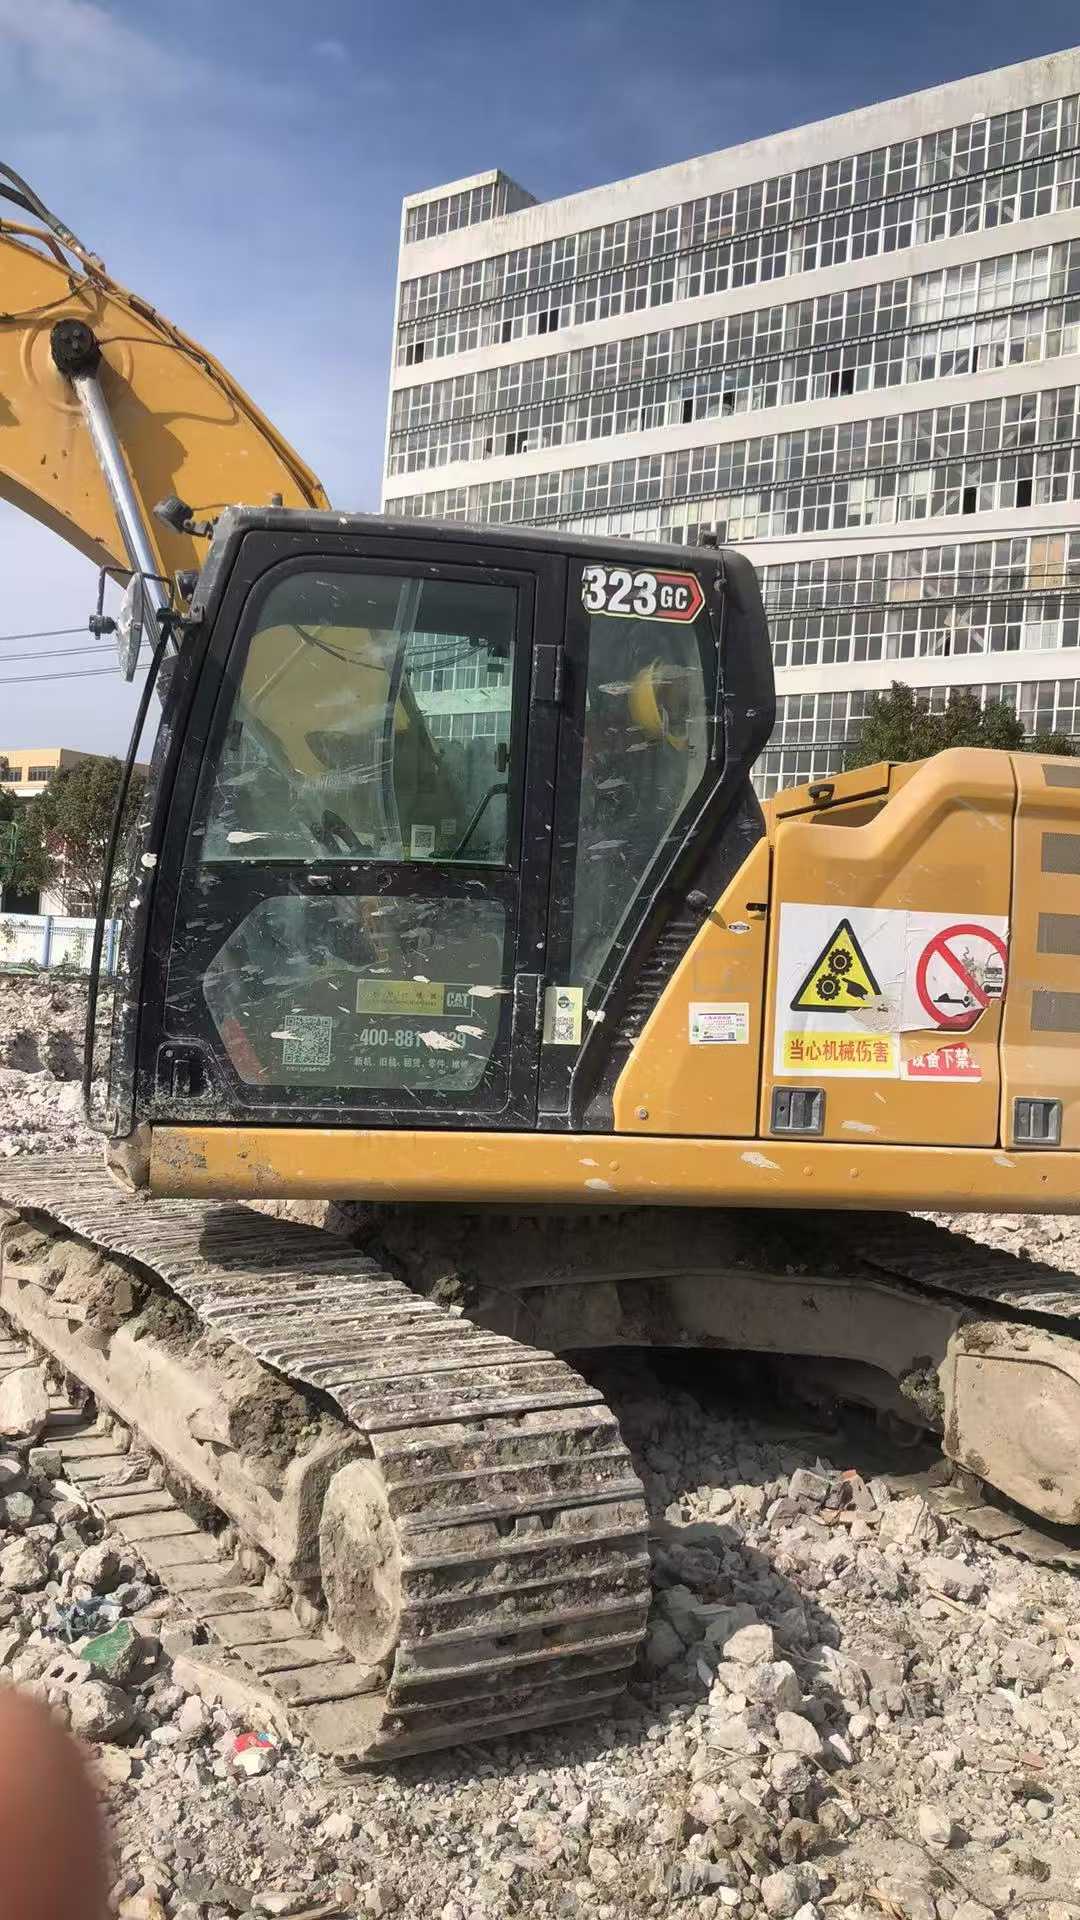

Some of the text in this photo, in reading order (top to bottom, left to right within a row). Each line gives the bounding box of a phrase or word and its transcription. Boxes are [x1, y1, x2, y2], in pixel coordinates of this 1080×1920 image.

[585, 568, 688, 615] 323 GC
[446, 992, 470, 1008] CAT
[360, 1028, 466, 1049] 400-88129
[790, 1039, 889, 1063] 当心机械伤害
